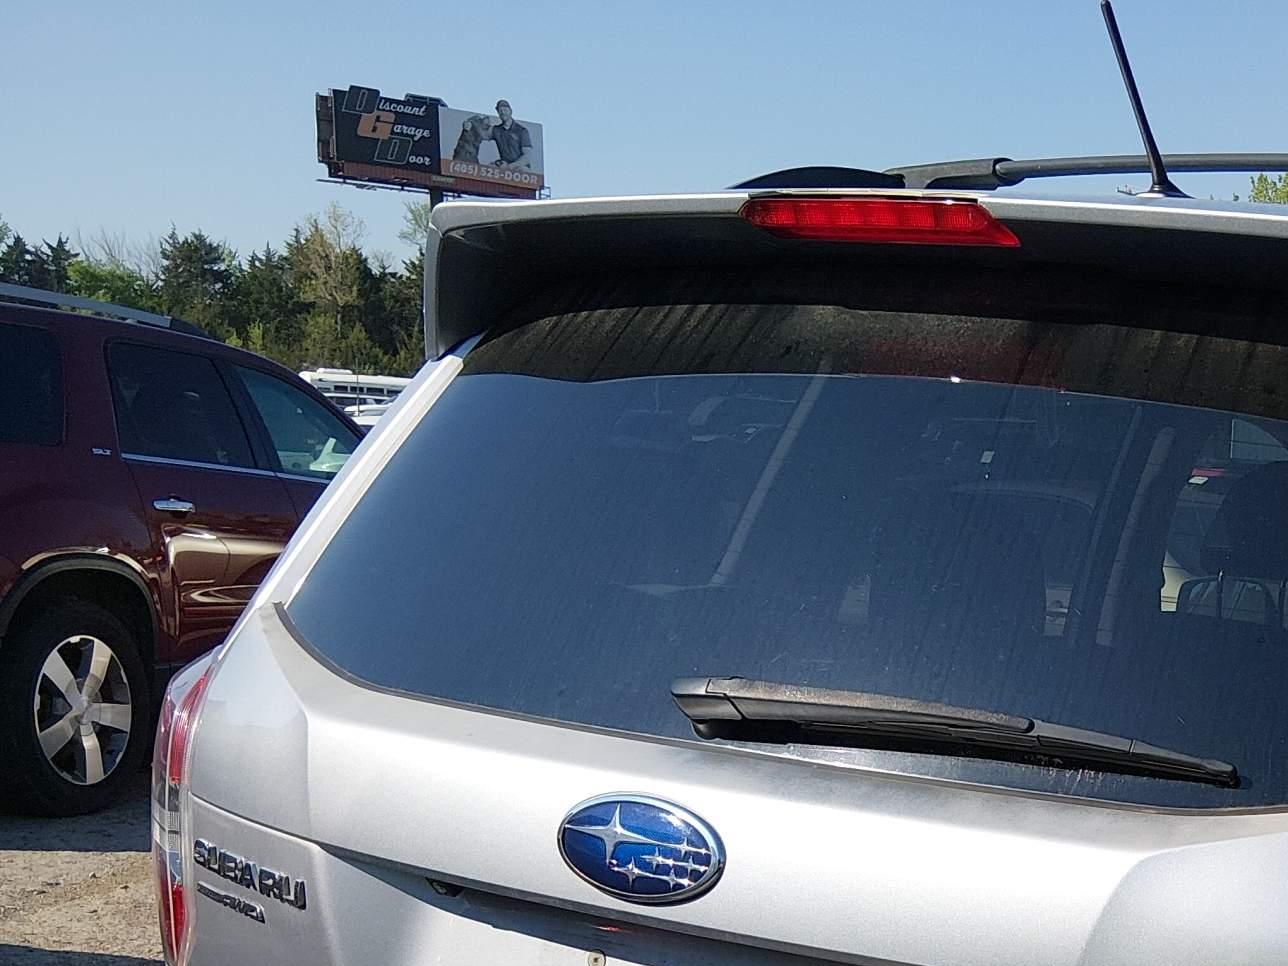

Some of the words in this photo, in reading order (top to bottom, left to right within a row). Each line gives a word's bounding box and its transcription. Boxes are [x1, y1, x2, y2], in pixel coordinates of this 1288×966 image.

[342, 85, 427, 117] Discount
[357, 110, 431, 141] Garage
[374, 135, 432, 165] Door
[193, 838, 307, 911] SUBARU
